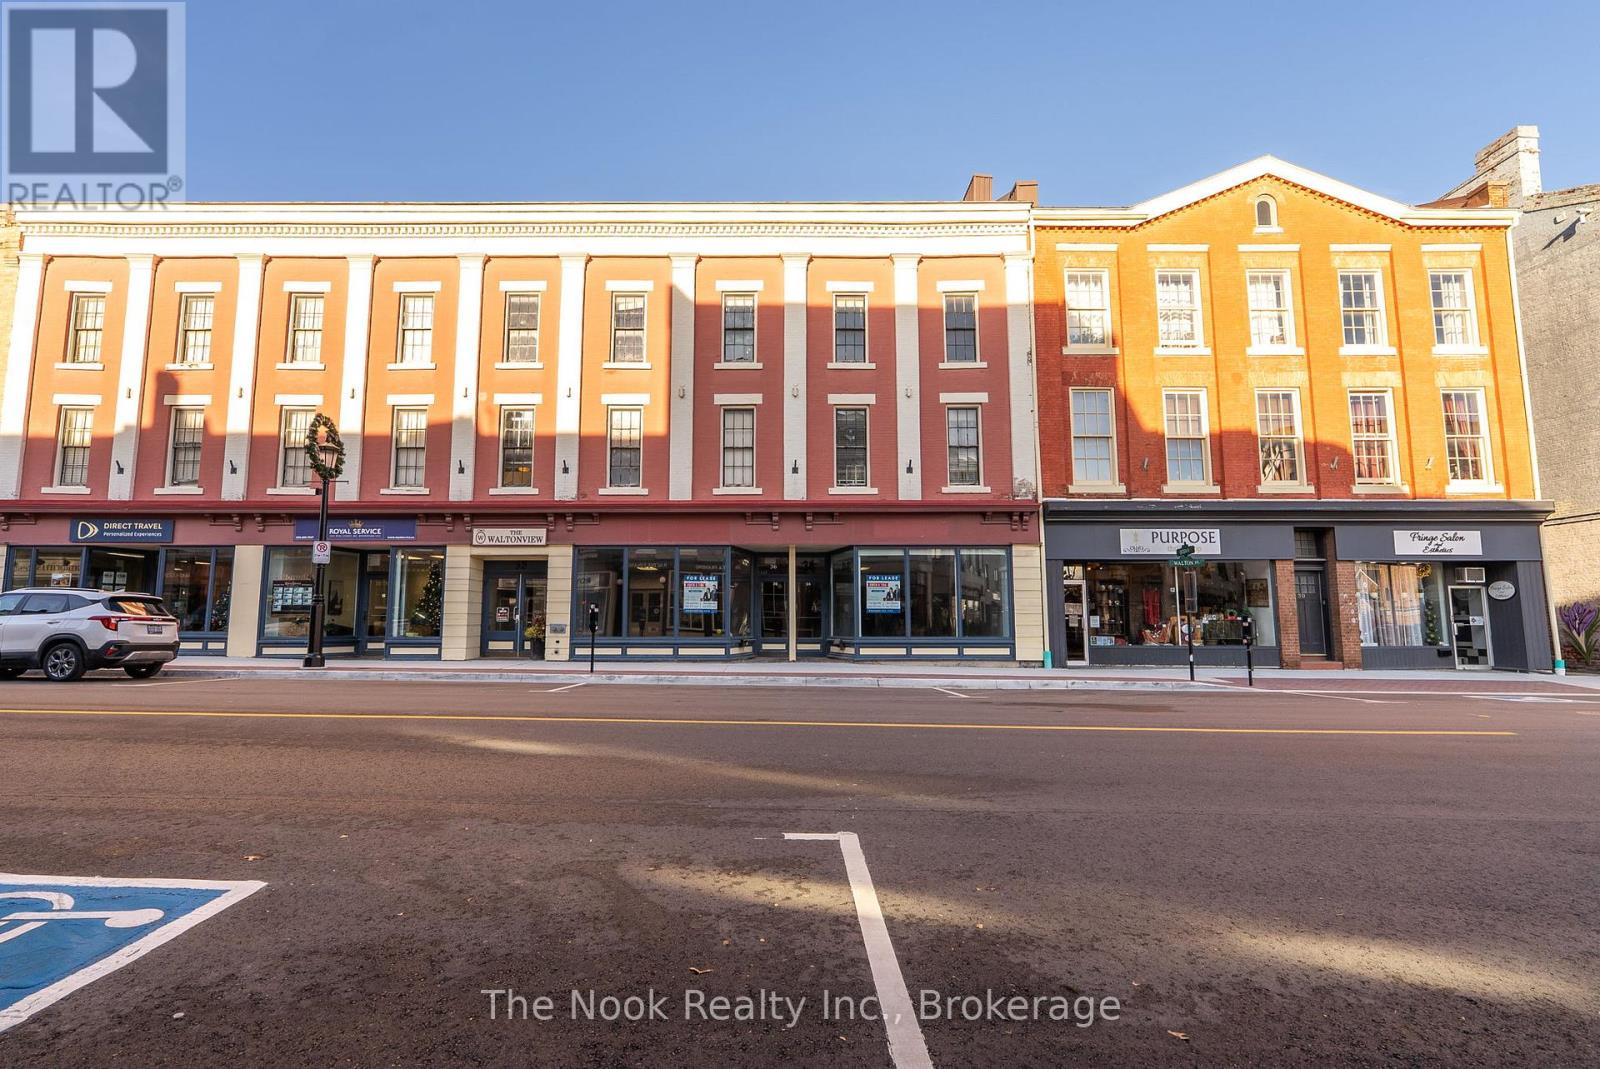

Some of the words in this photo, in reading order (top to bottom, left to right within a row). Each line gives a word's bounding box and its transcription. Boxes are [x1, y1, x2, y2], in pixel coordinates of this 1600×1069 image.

[103, 522, 132, 530] DIRECT
[134, 522, 162, 530] TRAVEL
[1151, 531, 1216, 543] PURPOSE
[1410, 532, 1438, 546] Fringe
[1440, 532, 1465, 542] Salon
